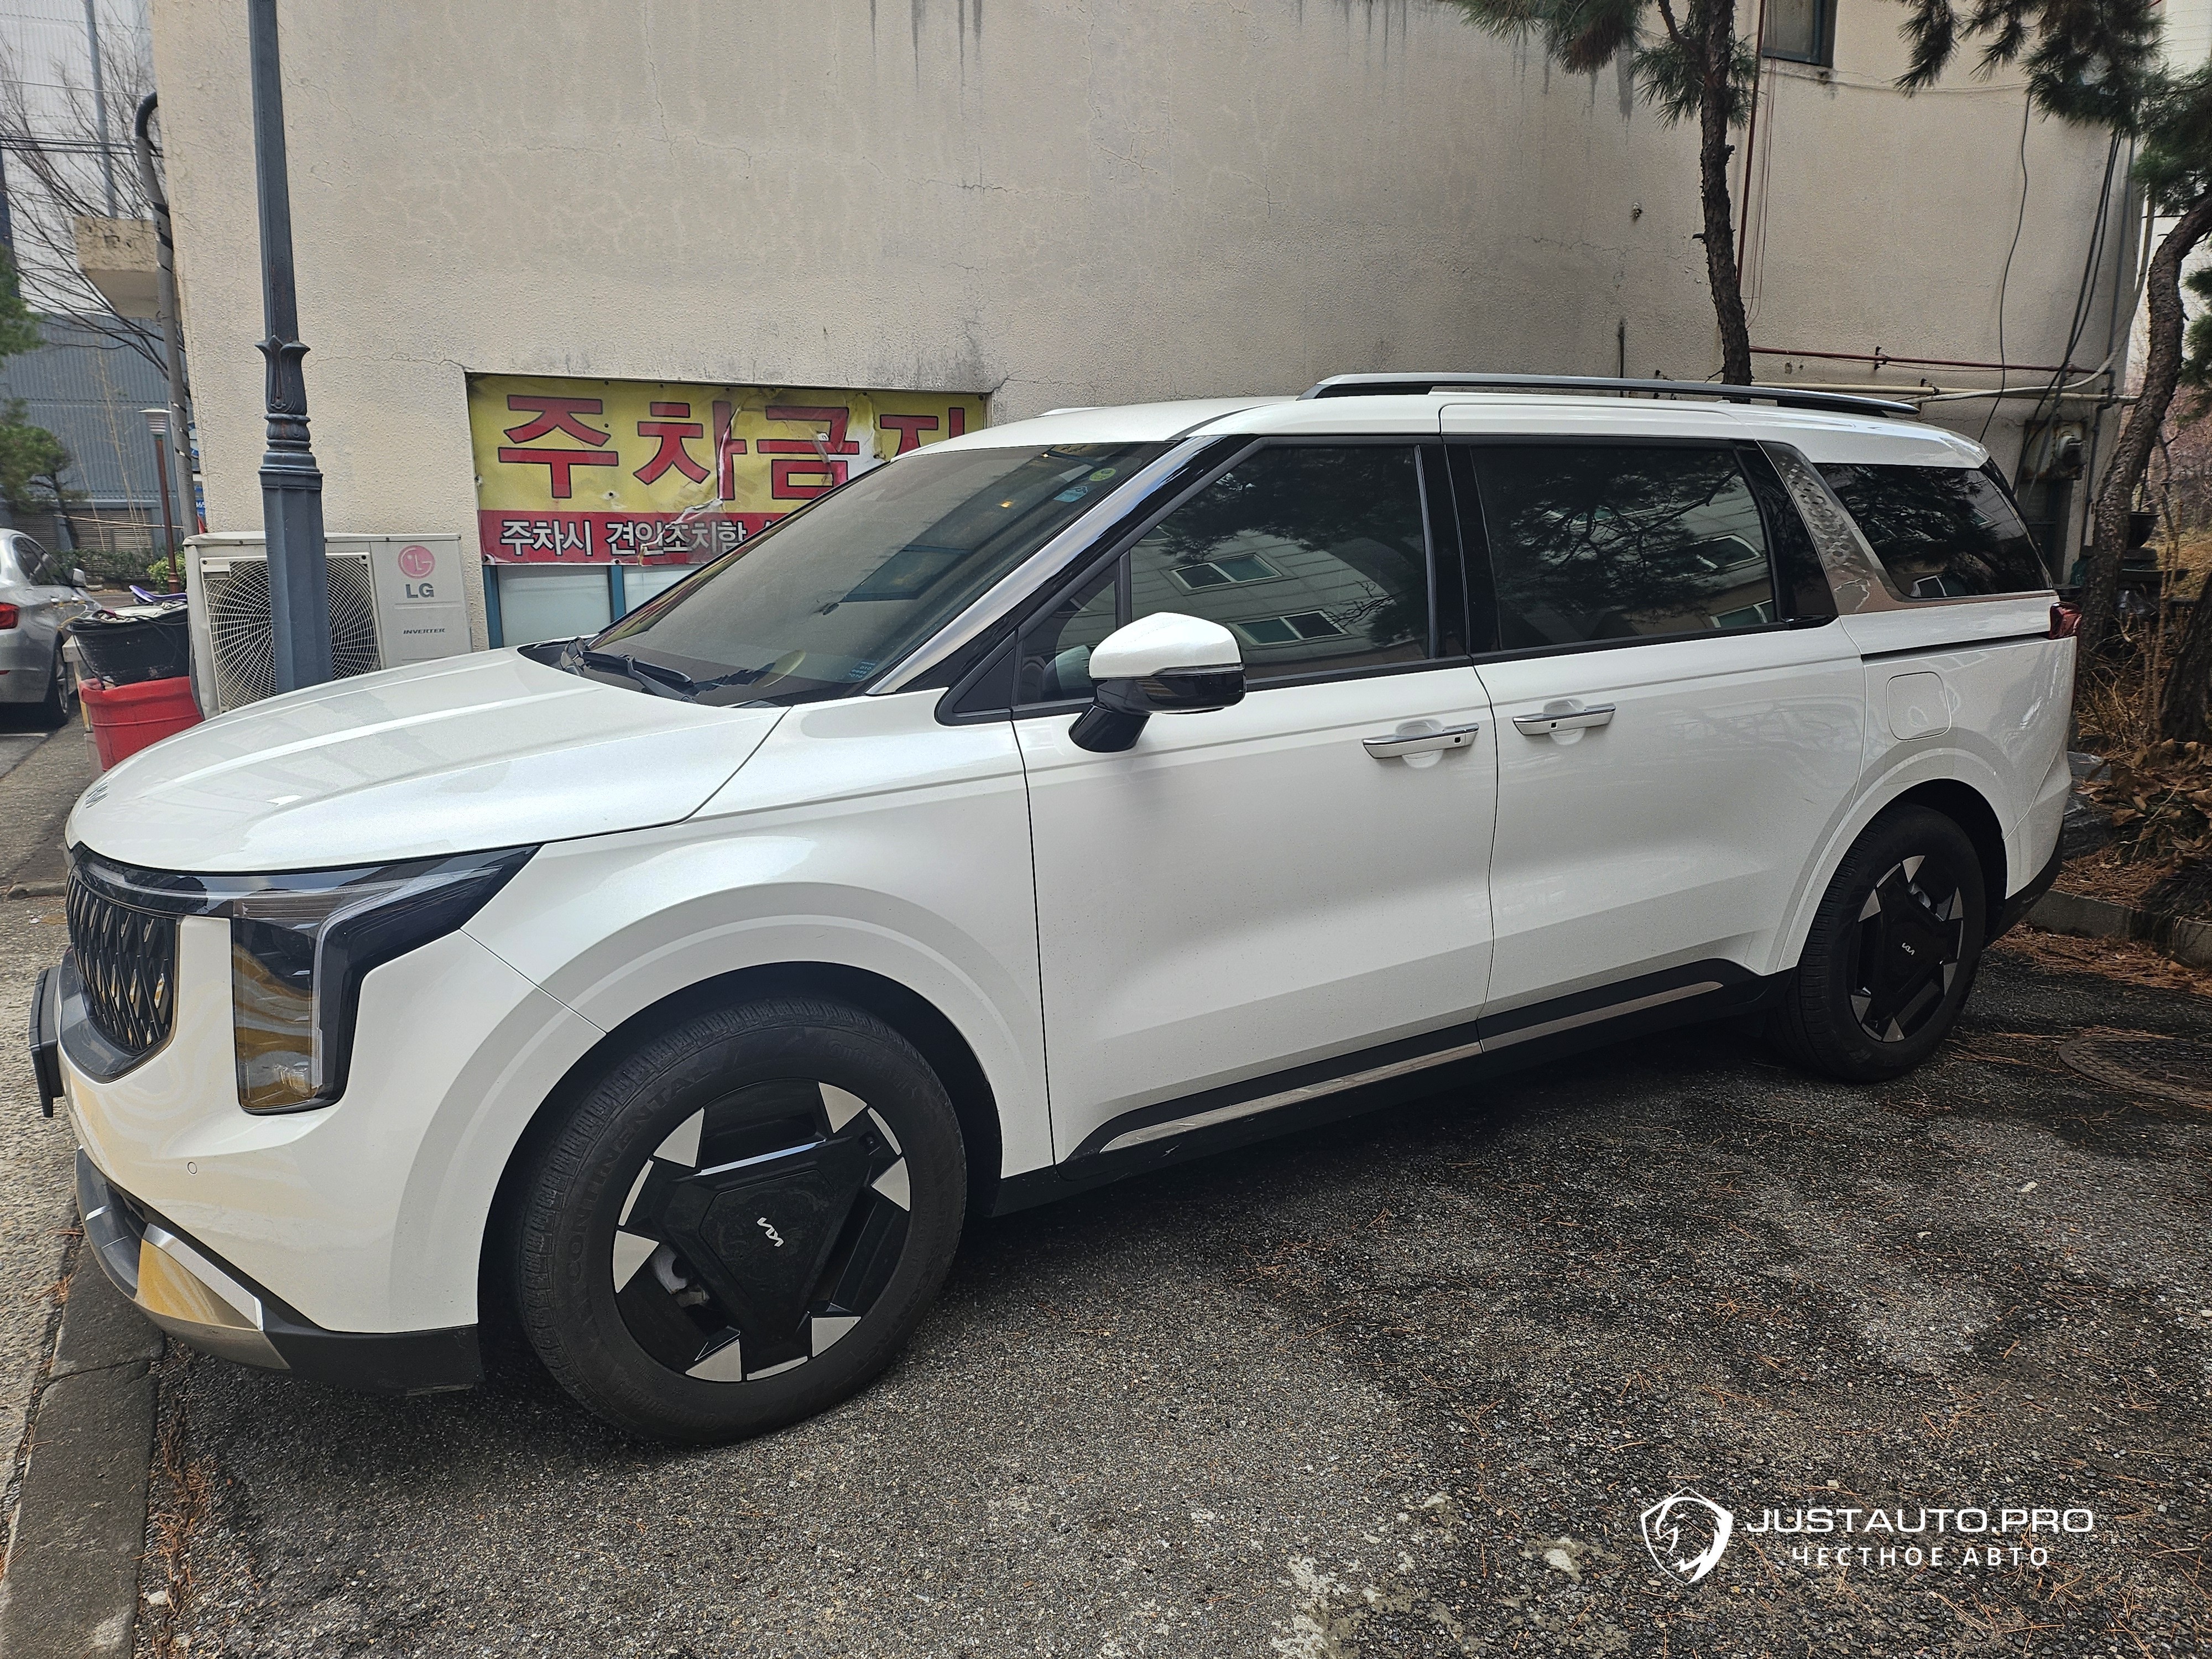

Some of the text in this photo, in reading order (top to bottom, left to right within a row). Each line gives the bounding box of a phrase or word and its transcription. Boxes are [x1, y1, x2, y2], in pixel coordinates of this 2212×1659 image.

[500, 520, 593, 555] 주차시
[405, 583, 434, 598] LG
[564, 1065, 714, 1287] CONTINENTAL
